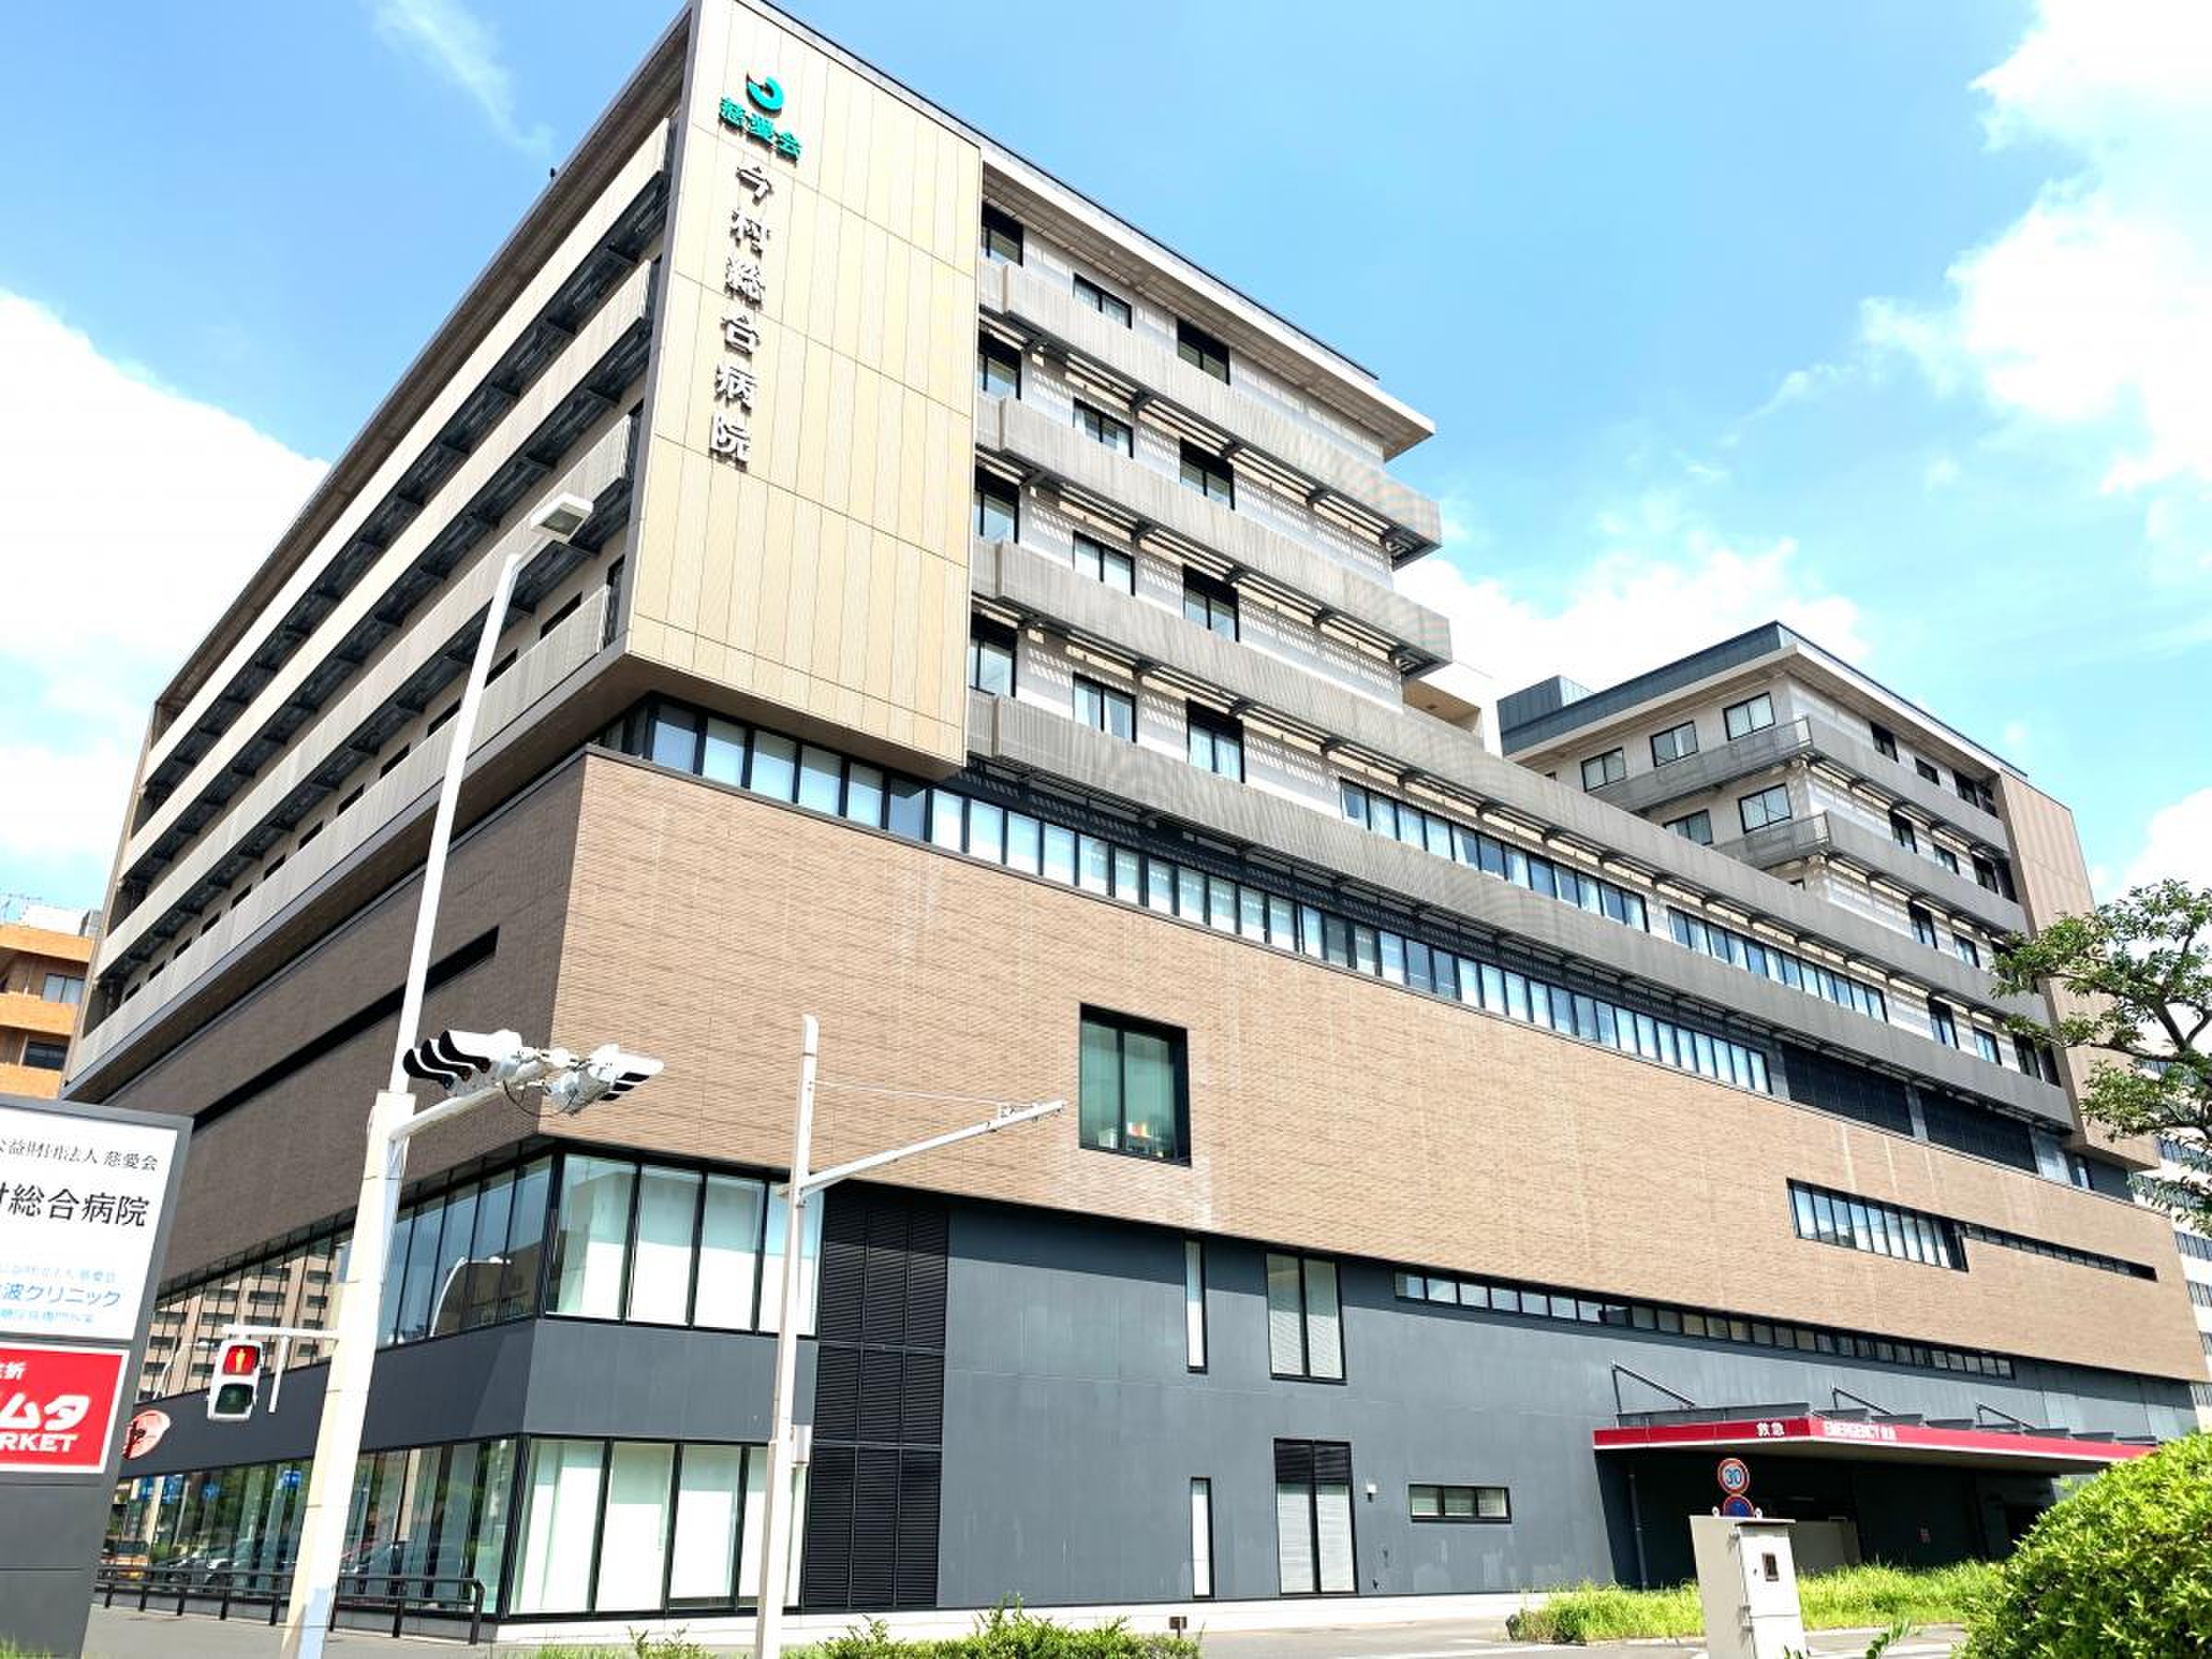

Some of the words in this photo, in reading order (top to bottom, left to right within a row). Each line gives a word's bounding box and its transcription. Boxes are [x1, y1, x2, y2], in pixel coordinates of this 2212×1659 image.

[709, 165, 773, 467] 今村総合病院
[104, 1150, 159, 1171] 慈愛会
[0, 1181, 150, 1228] 総合病院
[0, 1282, 121, 1308] 波クリニック
[0, 1361, 26, 1381] 折
[1724, 1467, 1742, 1485] 30
